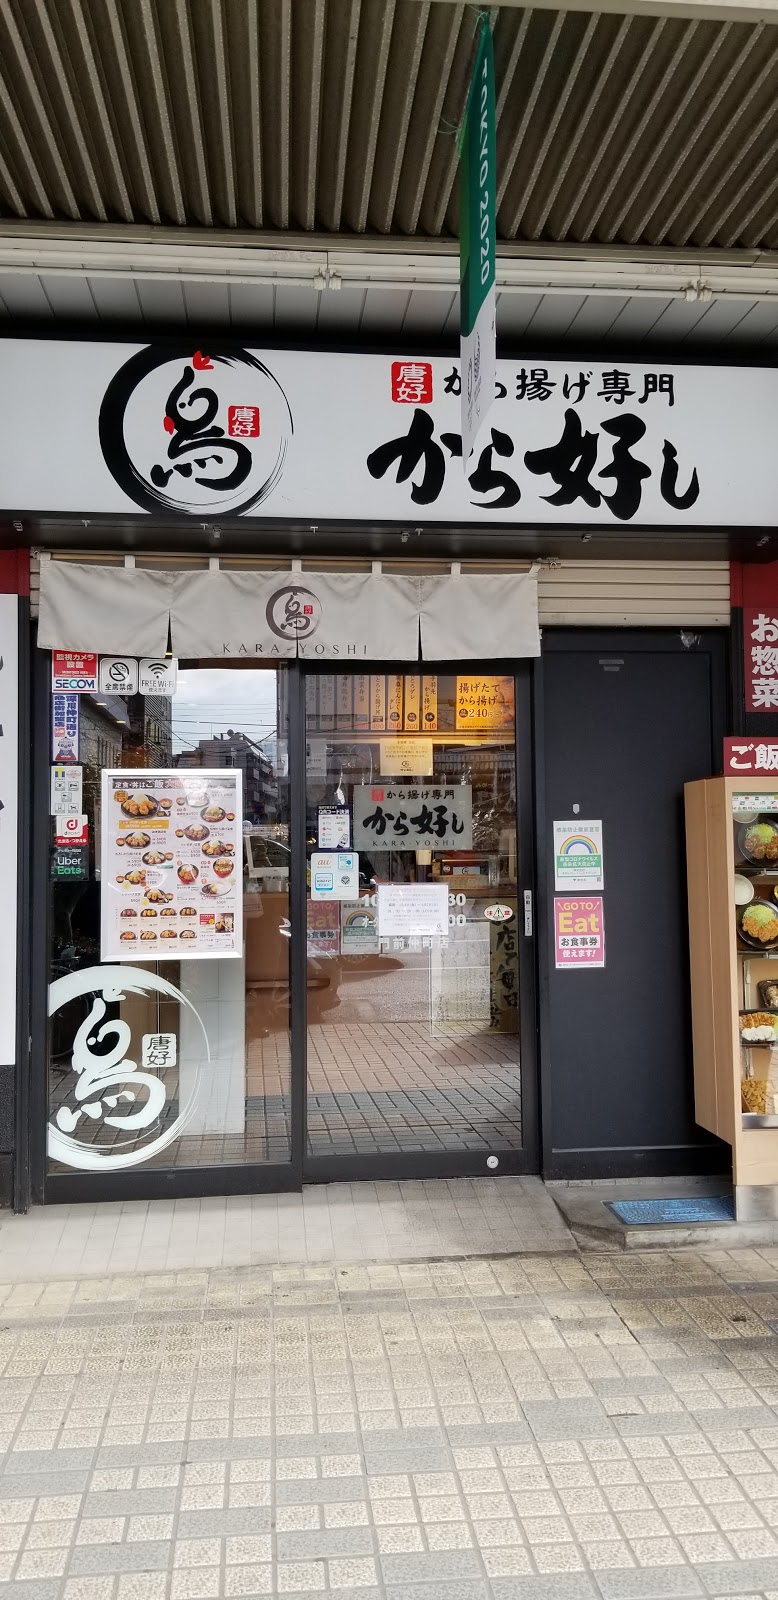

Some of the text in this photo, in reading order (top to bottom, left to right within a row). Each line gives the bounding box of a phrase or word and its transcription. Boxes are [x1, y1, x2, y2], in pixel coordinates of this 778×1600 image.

[478, 57, 490, 286] TOKYO 2020
[395, 363, 430, 402] 唐好
[230, 406, 259, 436] 唐好
[222, 641, 370, 656] KARA-YOSHI
[55, 652, 95, 662] 監視カメラ
[66, 661, 85, 669] 設置
[55, 679, 95, 689] SECOM
[104, 682, 134, 691] 全席禁煙
[141, 679, 158, 687] FREE
[458, 682, 500, 694] 揚げたて
[458, 695, 498, 706] から揚げ
[729, 742, 778, 771] ご飯
[386, 789, 455, 800] から揚げ専門
[362, 804, 465, 838] から好し
[372, 839, 456, 847] KARA-YOSHI
[57, 856, 82, 865] Uber
[57, 866, 82, 875] Eats
[563, 902, 594, 911] GO TO
[558, 911, 600, 933] Eat
[378, 936, 450, 949] 門前仲町店
[560, 936, 598, 947] お食事券
[145, 1035, 174, 1067] 唐好
